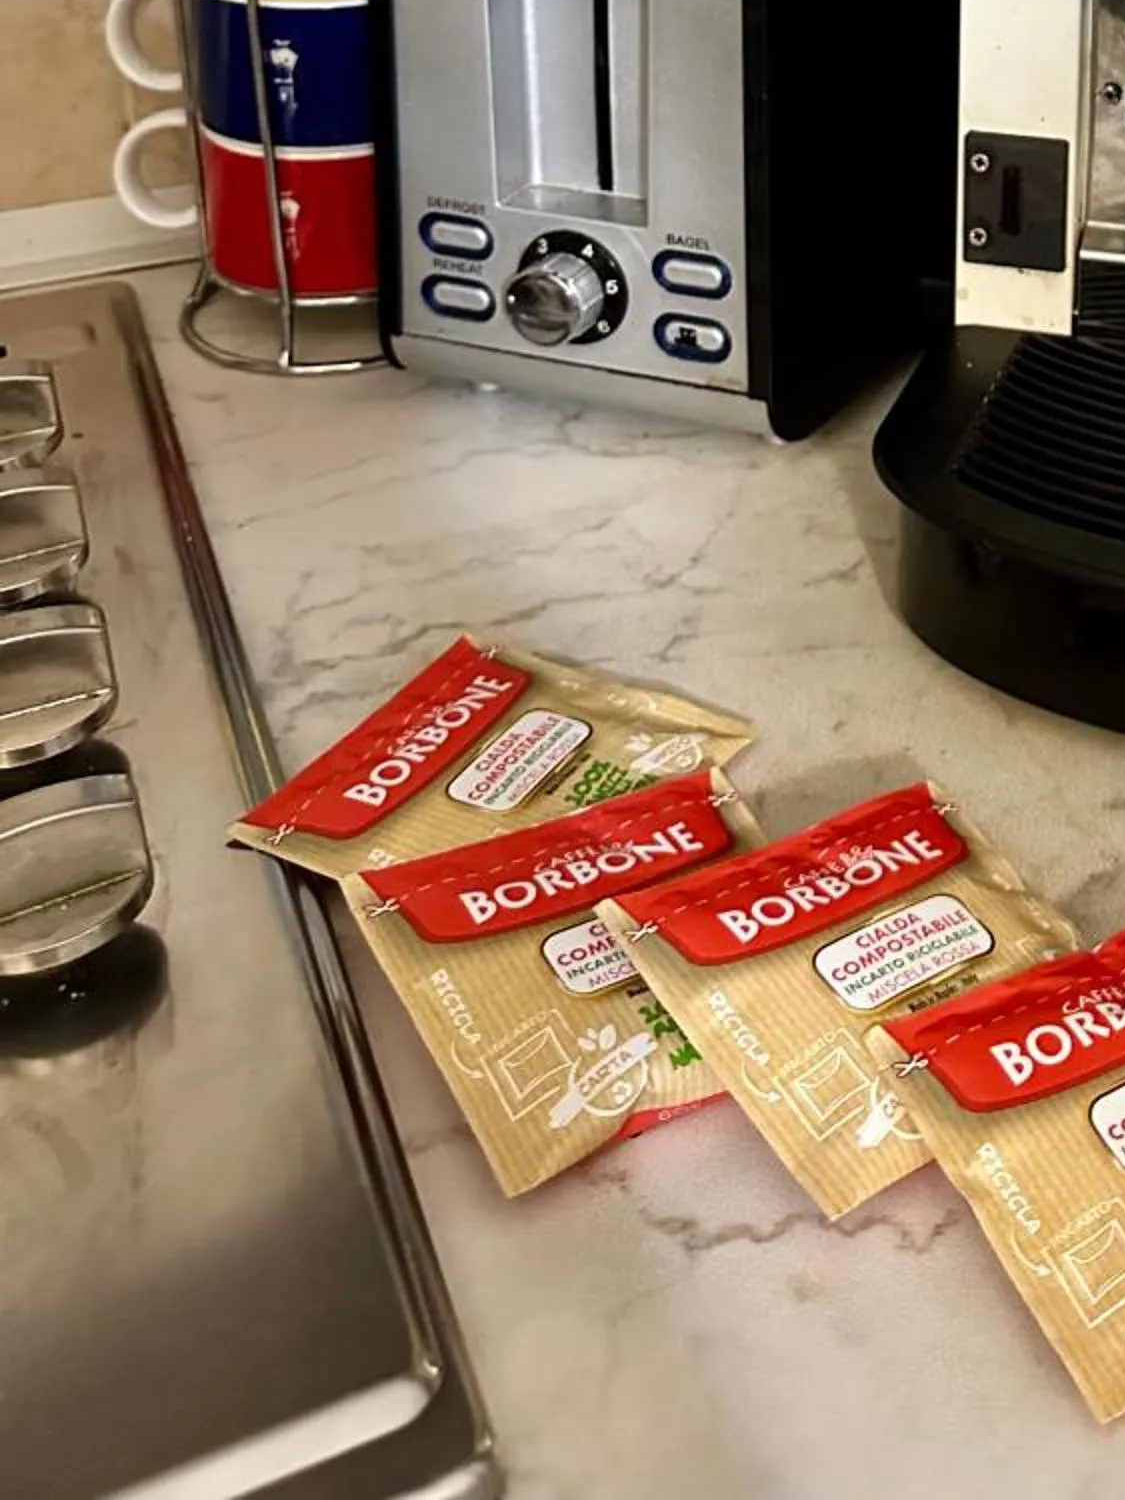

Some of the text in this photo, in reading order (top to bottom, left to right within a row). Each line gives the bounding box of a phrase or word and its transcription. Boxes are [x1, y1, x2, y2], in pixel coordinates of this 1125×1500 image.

[537, 237, 549, 254] 3
[581, 243, 594, 258] 4
[342, 674, 513, 809] BORBONE
[458, 821, 704, 925] BORBONE
[716, 829, 944, 944] BORBONE
[831, 908, 969, 981] COMPOSTABILE
[855, 912, 922, 949] CIALDA
[844, 958, 905, 995] INCARTO
[867, 963, 933, 1003] MISCELA
